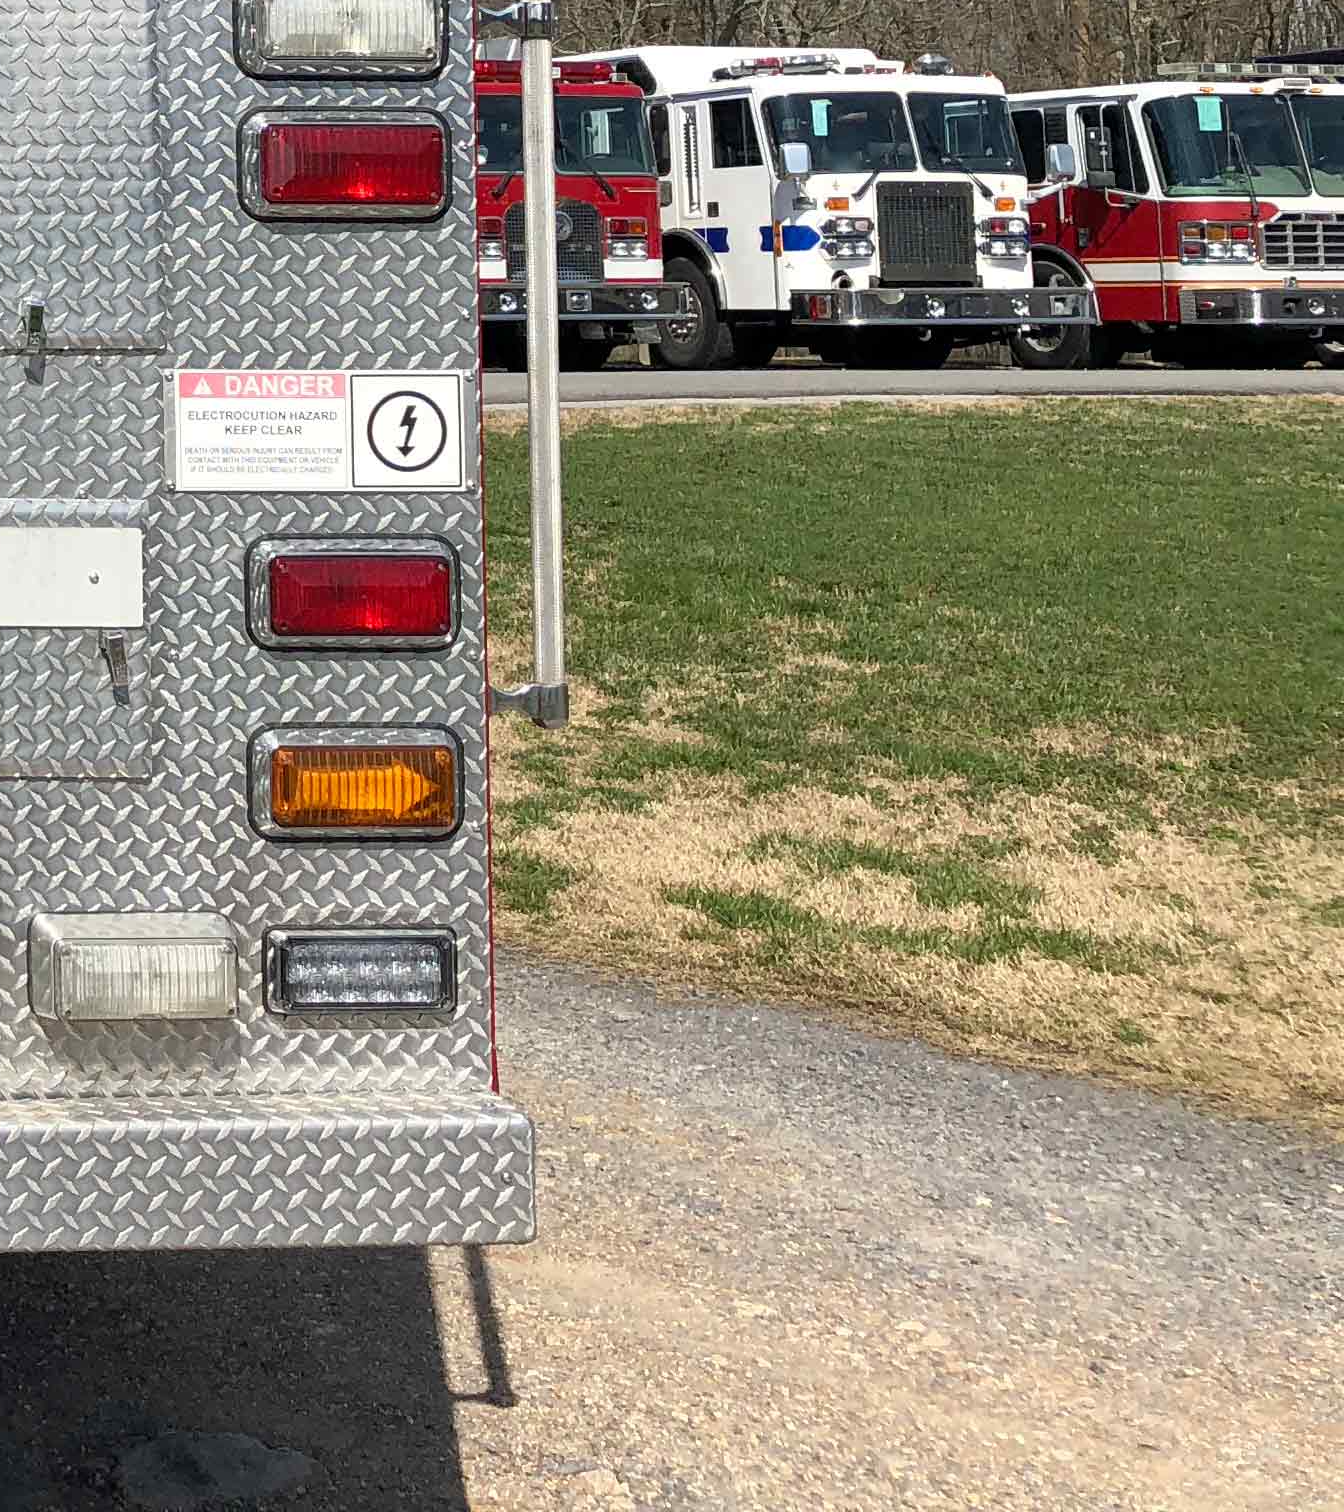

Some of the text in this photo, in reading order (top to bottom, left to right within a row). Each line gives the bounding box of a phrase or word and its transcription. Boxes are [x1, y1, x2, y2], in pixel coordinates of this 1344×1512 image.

[224, 375, 335, 396] DANGER
[187, 410, 337, 421] ELECTROCUTION HAZARD
[225, 425, 302, 435] KEEP CLEAR
